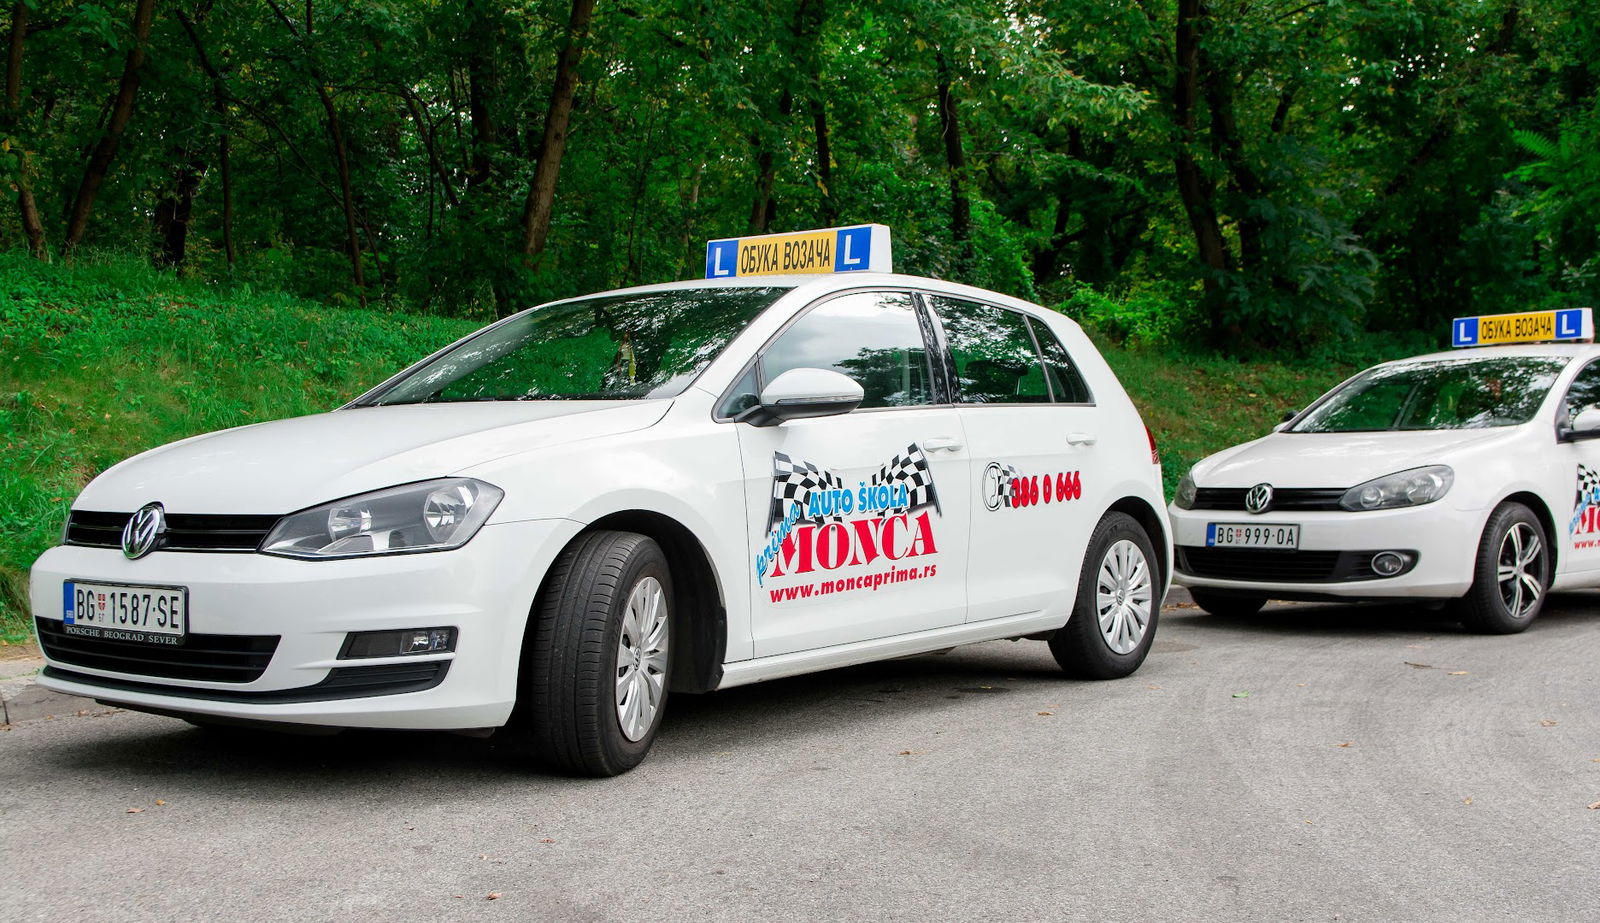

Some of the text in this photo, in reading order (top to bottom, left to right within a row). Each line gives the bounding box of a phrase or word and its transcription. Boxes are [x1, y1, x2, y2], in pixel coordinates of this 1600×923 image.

[714, 247, 729, 276] L
[741, 238, 830, 274] ОБУКА ВОЗАЧА
[843, 234, 861, 265] L
[1459, 322, 1473, 342] L
[1481, 316, 1552, 340] ОБУКА ВОЗАЧА
[1561, 314, 1576, 335] L
[807, 481, 908, 517] AUTO ŠKOLA
[1011, 470, 1081, 509] 386 0 666
[1217, 527, 1233, 544] BG
[1574, 506, 1600, 534] M
[755, 502, 803, 586] prima
[769, 510, 939, 578] MONCA
[769, 564, 937, 603] www.moncaprima.rs
[77, 588, 95, 621] BG
[66, 626, 178, 645] PORSCHE BEOGRAD SEVER
